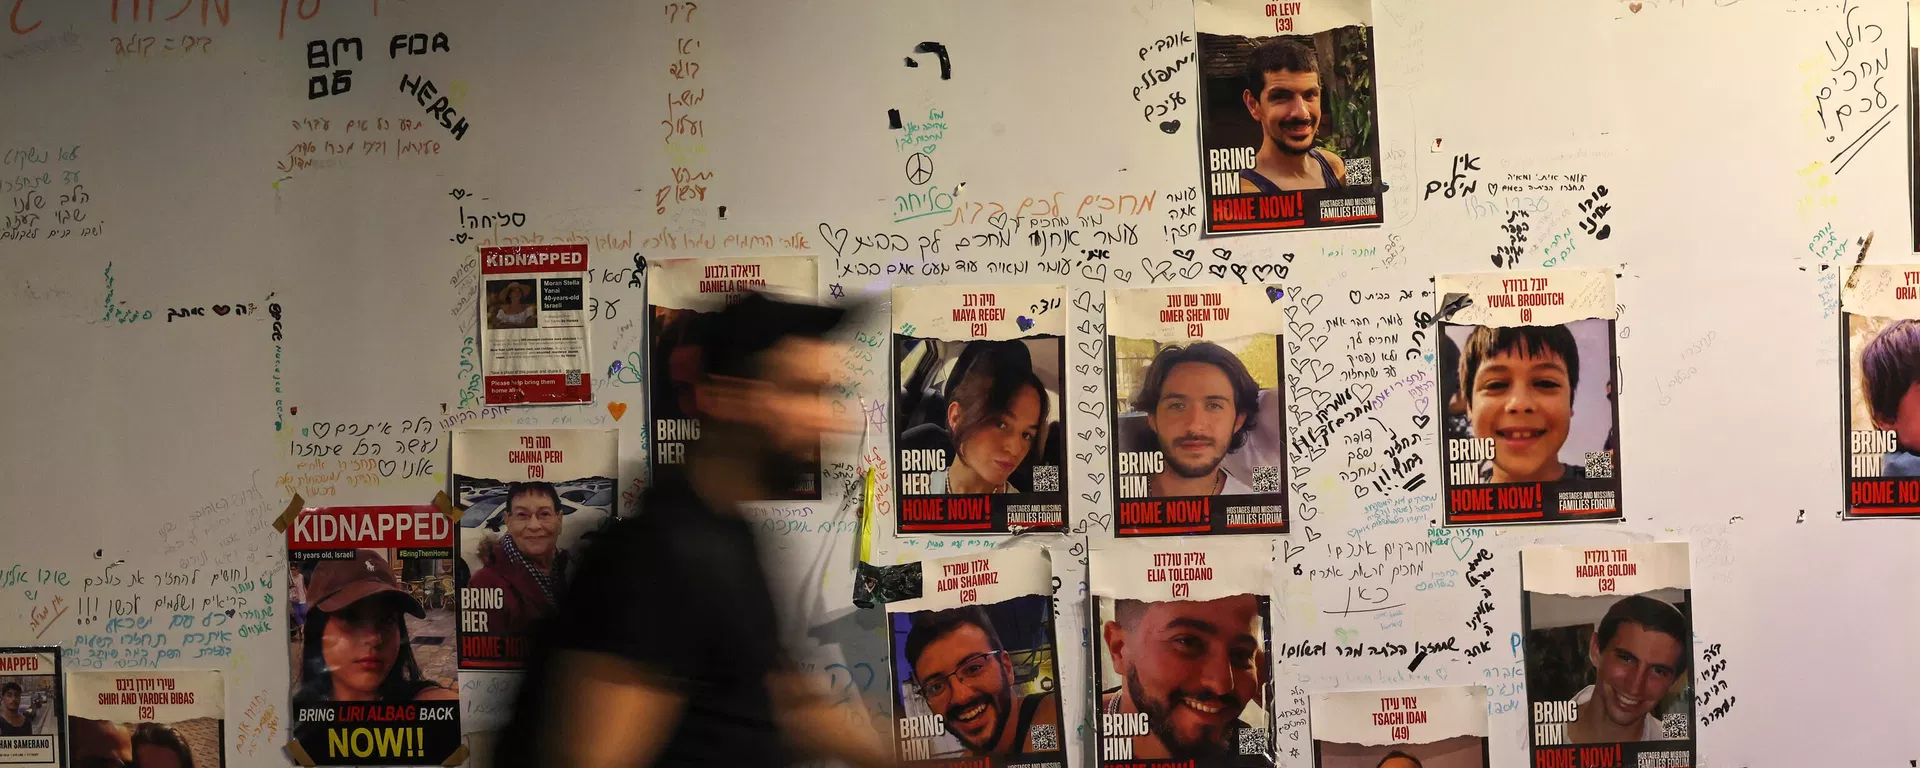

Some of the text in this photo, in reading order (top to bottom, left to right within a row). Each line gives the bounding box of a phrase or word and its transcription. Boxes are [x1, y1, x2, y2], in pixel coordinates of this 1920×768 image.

[1266, 2, 1300, 16] OR LEVY
[1275, 18, 1293, 32] (33)
[1139, 31, 1192, 60] אוהבים
[1826, 7, 1882, 71] כולנו
[308, 32, 450, 69] BM FOR
[1133, 53, 1195, 101] ומתפללים
[1816, 48, 1887, 119] מחכים
[400, 74, 469, 140] HERSH
[1144, 91, 1187, 122] עליכם
[1210, 147, 1255, 171] BRING
[1453, 154, 1481, 178] אין
[1211, 173, 1240, 195] HIM
[1424, 174, 1477, 200] מילים
[14, 185, 89, 213] הלב שלנו
[1167, 187, 1196, 202] עומר
[1213, 192, 1304, 221] HOME NOW!
[1320, 205, 1376, 218] FAMILIES FORUM
[487, 253, 582, 267] KIDNAPPED
[705, 265, 760, 279] דניאלה גלבוע
[700, 279, 734, 293] DANIELA
[1502, 278, 1547, 293] יובל ברודץ
[1896, 287, 1917, 300] ORIA
[963, 294, 994, 306] מיה רגב
[1167, 293, 1221, 307] עומר שם טוב
[1488, 293, 1564, 307] YUVAL BRODUTCH
[953, 309, 1005, 321] MAYA REGEV
[1160, 309, 1229, 322] OMER SHEM TOV
[1351, 317, 1370, 325] חבר
[1521, 308, 1532, 322] (8)
[971, 323, 987, 337] (21)
[1187, 324, 1203, 338] (21)
[1369, 334, 1398, 344] מחכים
[1347, 350, 1397, 367] ולא נפסיק
[335, 416, 432, 437] הלב איתכם
[657, 419, 700, 441] BRING
[291, 438, 438, 456] נעשה הכל שתחזרו
[520, 437, 551, 448] חנה פרי
[1449, 438, 1495, 461] BRING
[1852, 430, 1896, 453] BRING
[509, 451, 562, 463] CHANNA PERI
[658, 442, 685, 464] HER
[902, 449, 946, 471] BRING
[1119, 452, 1163, 474] BRING
[1852, 456, 1880, 477] HIM
[528, 465, 544, 479] (79)
[1451, 463, 1478, 485] HIM
[903, 472, 930, 495] HER
[1120, 476, 1147, 498] HIM
[1452, 484, 1542, 512] HOME NOW!
[1852, 481, 1894, 505] HOME
[903, 495, 990, 521] HOME NOW!
[1121, 498, 1209, 524] HOME NOW!
[1559, 499, 1614, 511] FAMILIES FORUM
[1008, 512, 1062, 523] FAMILIES FORUM
[1227, 513, 1282, 525] FAMILIES FORUM
[294, 513, 449, 542] KIDNAPPED
[400, 550, 448, 558] #BringThemHome
[1385, 542, 1432, 560] מחבקים
[1584, 550, 1627, 564] הדר גולדין
[944, 559, 988, 576] אלון שמריז
[1154, 553, 1205, 567] אליה טולדנו
[154, 569, 199, 586] להחזיר
[1148, 568, 1212, 582] ELIA TOLEDANO
[1576, 564, 1636, 578] HADAR GOLDIN
[937, 572, 998, 592] ALON SHAMRIZ
[1172, 583, 1189, 597] (27)
[1599, 579, 1615, 592] (32)
[202, 596, 246, 611] בריאים
[461, 588, 503, 609] BRING
[960, 589, 977, 603] (26)
[1345, 587, 1388, 617] כאן
[462, 611, 488, 632] HER
[462, 636, 500, 657] HOME
[116, 679, 174, 691] שירי וירדן ביבס
[99, 692, 194, 704] SHIRI AND YARDEN BIBAS
[1381, 697, 1417, 710] צחי עידן
[139, 707, 155, 720] (32)
[299, 706, 454, 721] BRING LIRI ALBAG BACK
[1373, 711, 1426, 726] TSACHI IDAN
[1534, 701, 1578, 723] BRING
[900, 714, 944, 737] BRING
[1104, 713, 1148, 735] BRING
[1392, 726, 1409, 740] (49)
[1536, 723, 1562, 745] HIM
[14, 740, 49, 749] SAMERANO
[329, 728, 423, 757] NOW!!
[902, 740, 930, 761] HIM
[1104, 737, 1132, 761] HIM
